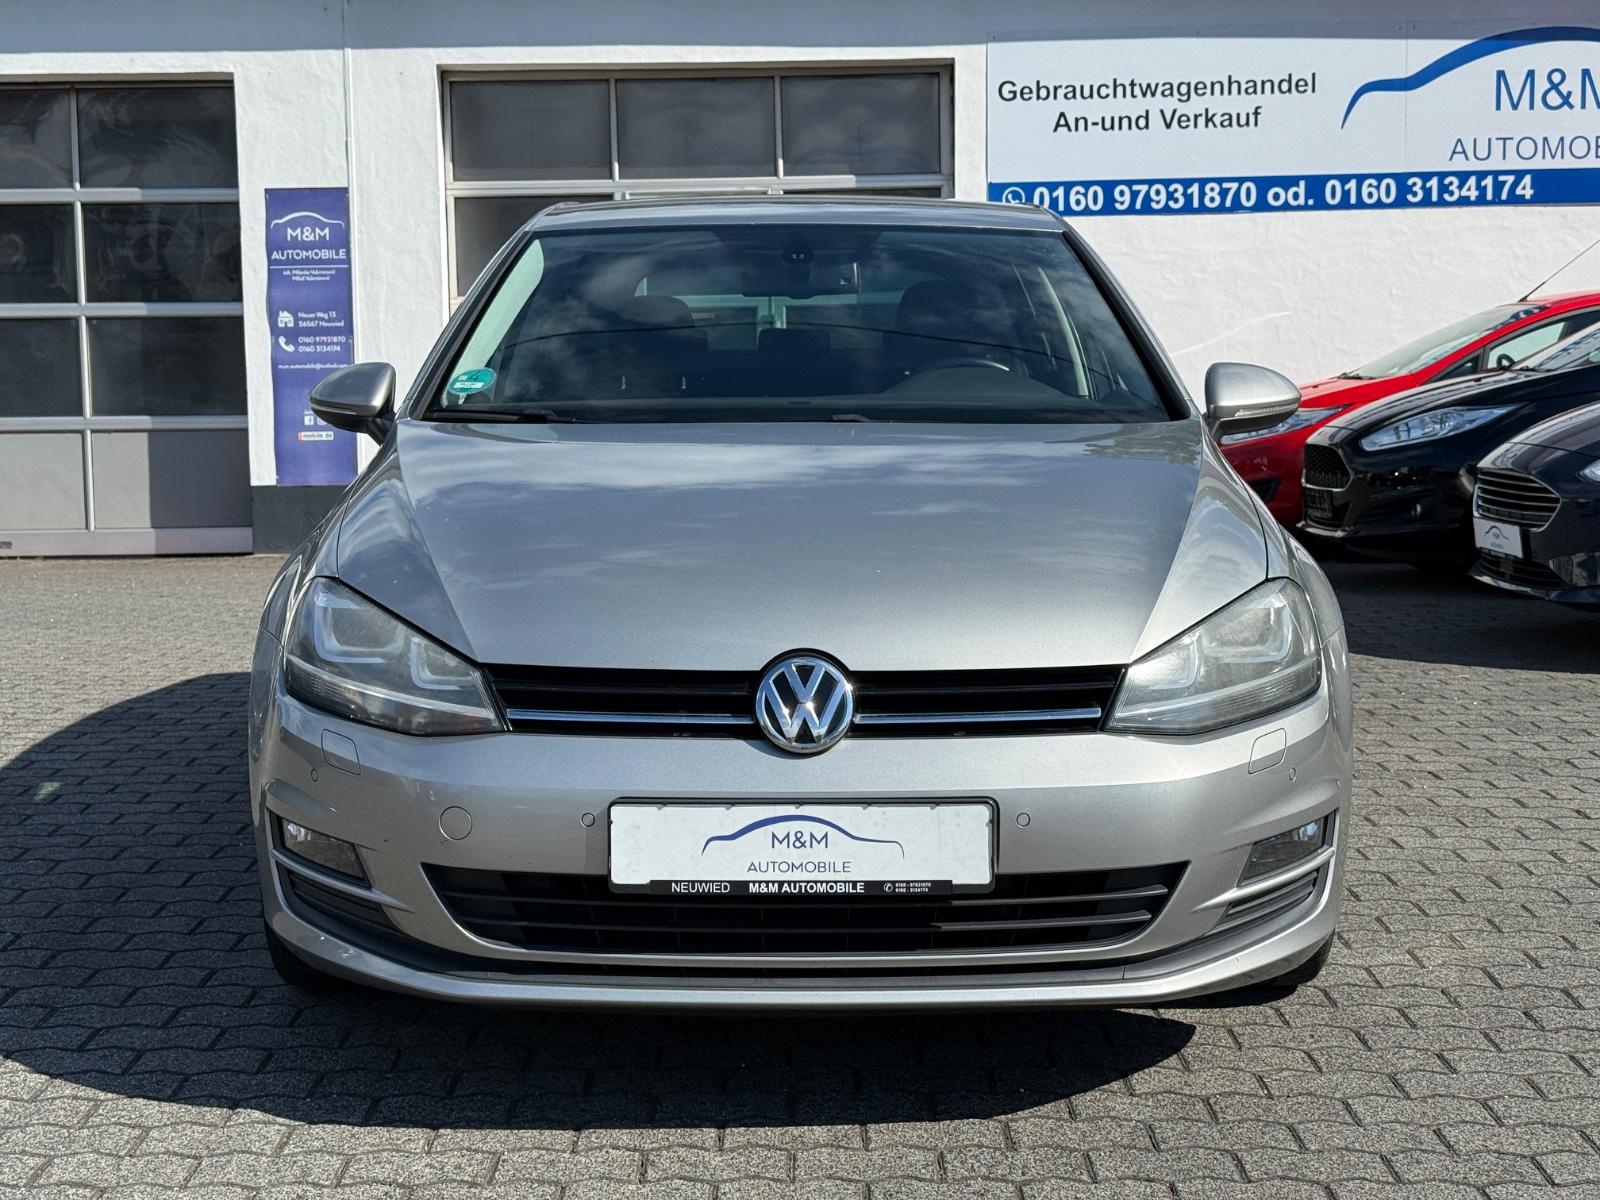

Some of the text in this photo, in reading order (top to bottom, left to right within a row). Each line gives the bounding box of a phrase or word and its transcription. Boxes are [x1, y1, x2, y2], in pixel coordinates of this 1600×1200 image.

[998, 72, 1317, 103] Gebrauchtwagenhandel
[1053, 106, 1262, 133] An-und Verkauf
[1449, 135, 1600, 162] AUTOMO
[1033, 174, 1534, 212] 0160 97931870 od. 0160 3134174
[287, 226, 330, 241] M&M
[271, 249, 347, 260] AUTOMOBILE
[759, 658, 849, 747] VW
[771, 831, 829, 849] M&M
[747, 861, 851, 873] AUTOMOBILE
[671, 882, 865, 893] NEUWIED M&M AUTOMOBILE
